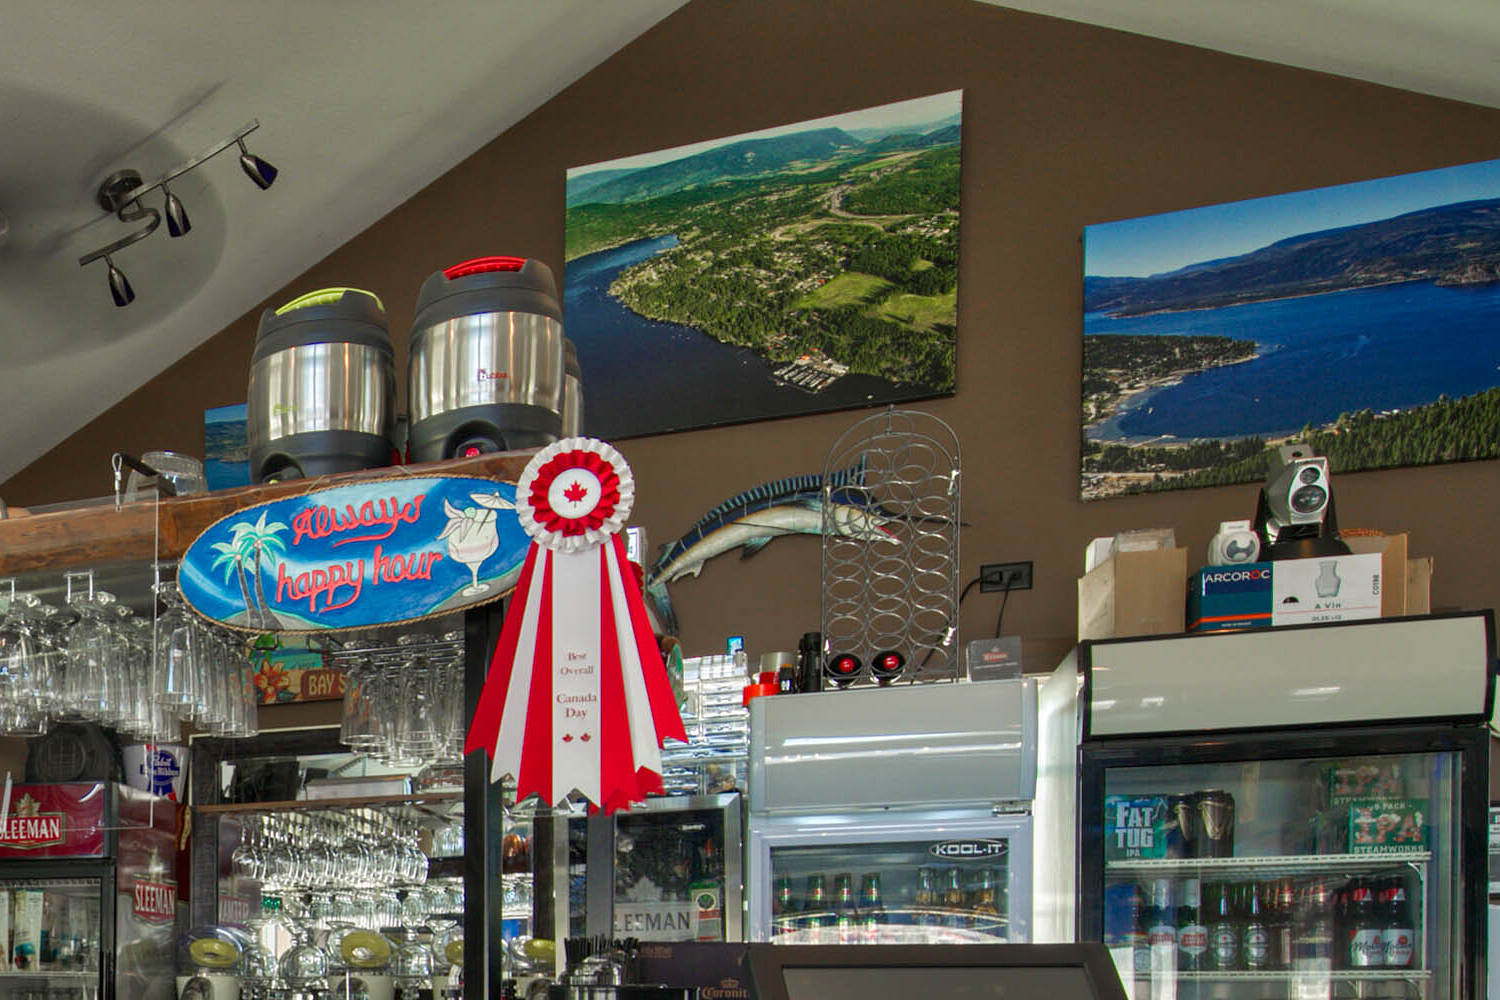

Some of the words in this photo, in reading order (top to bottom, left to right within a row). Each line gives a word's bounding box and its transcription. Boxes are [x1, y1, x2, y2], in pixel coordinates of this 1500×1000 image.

[292, 494, 427, 548] Always
[276, 558, 365, 614] happy
[372, 543, 444, 586] hour
[1205, 569, 1271, 584] ARCOROC
[567, 651, 588, 662] Best
[559, 665, 595, 676] Overall
[308, 672, 336, 696] BAY
[556, 692, 598, 704] Canada
[565, 706, 589, 721] Day
[1115, 801, 1154, 828] FAT
[1115, 828, 1154, 849] TUG
[135, 883, 176, 916] SLEEMAN
[613, 910, 691, 933] LEEMAN
[701, 986, 748, 1000] Coronit
